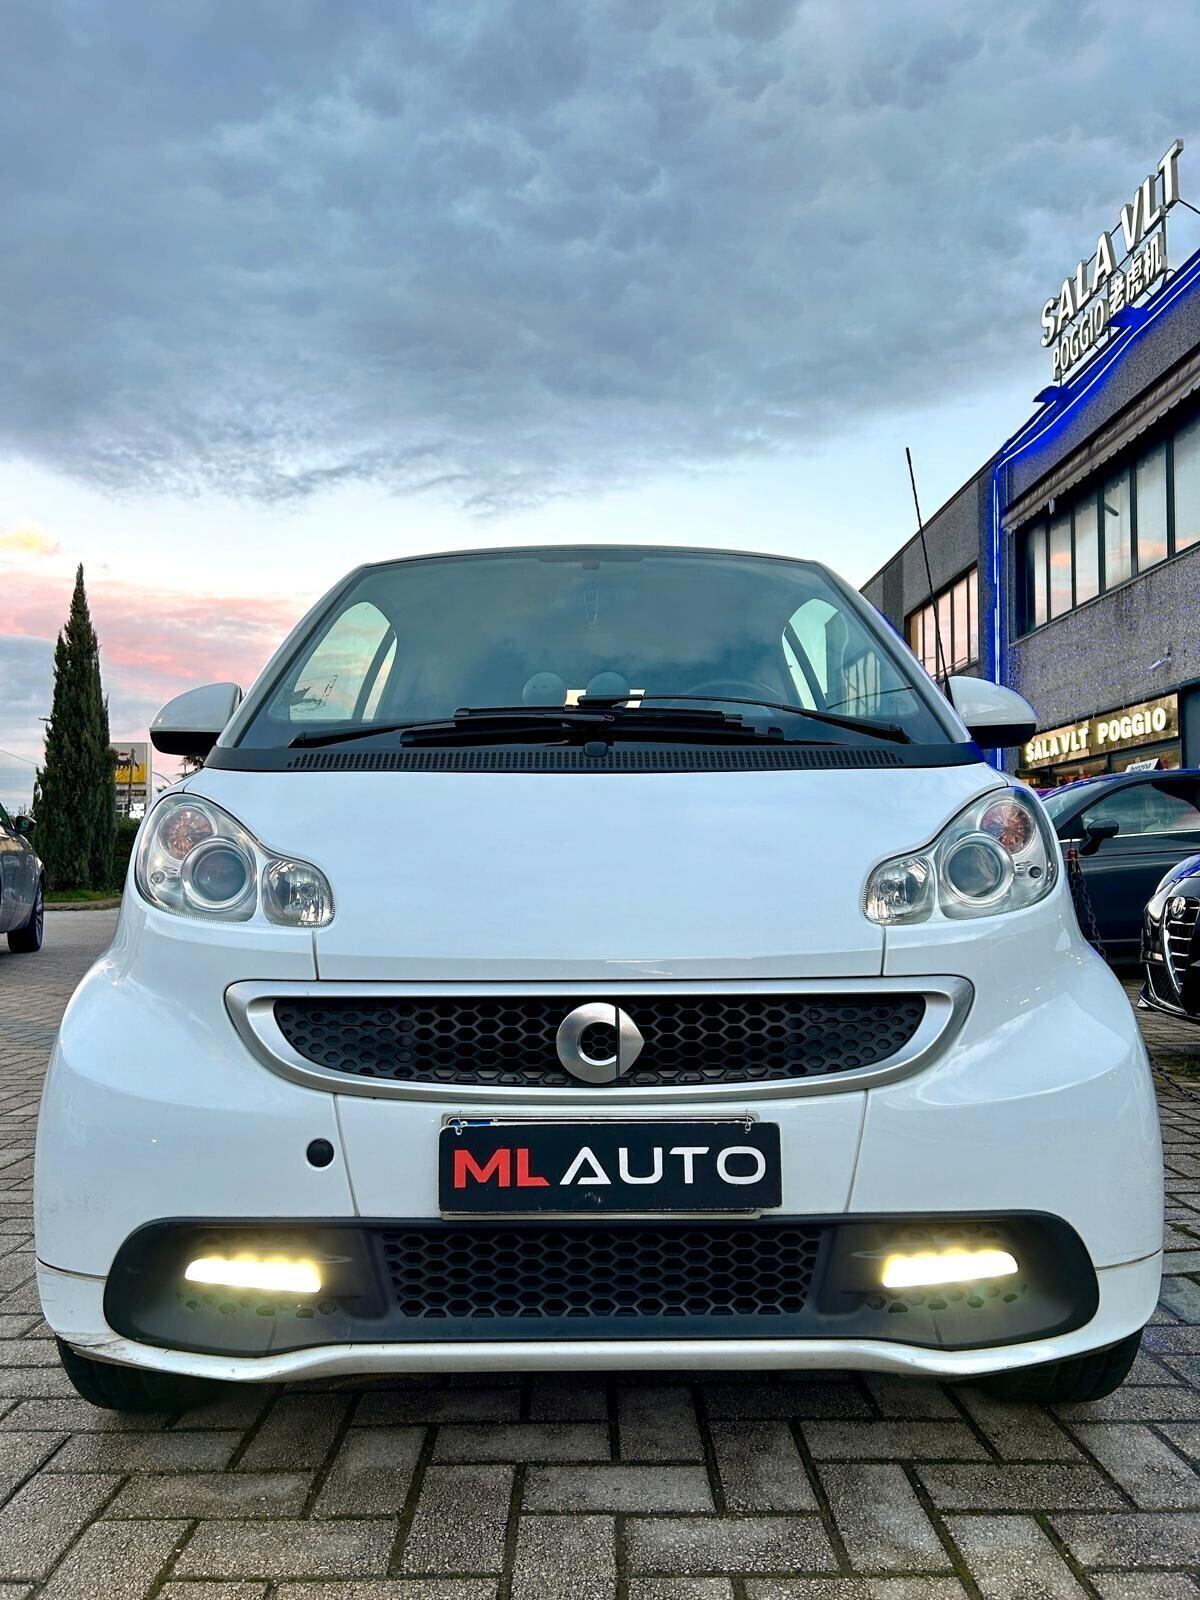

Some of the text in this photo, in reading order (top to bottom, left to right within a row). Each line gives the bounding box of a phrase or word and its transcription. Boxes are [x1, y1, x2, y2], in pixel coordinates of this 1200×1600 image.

[1040, 139, 1183, 348] SALA VLT
[1109, 232, 1167, 315] 老虎机
[1052, 298, 1110, 381] POGGIO
[1025, 708, 1167, 763] SALA VLT POGGIO
[453, 1145, 767, 1189] ML AUTO
